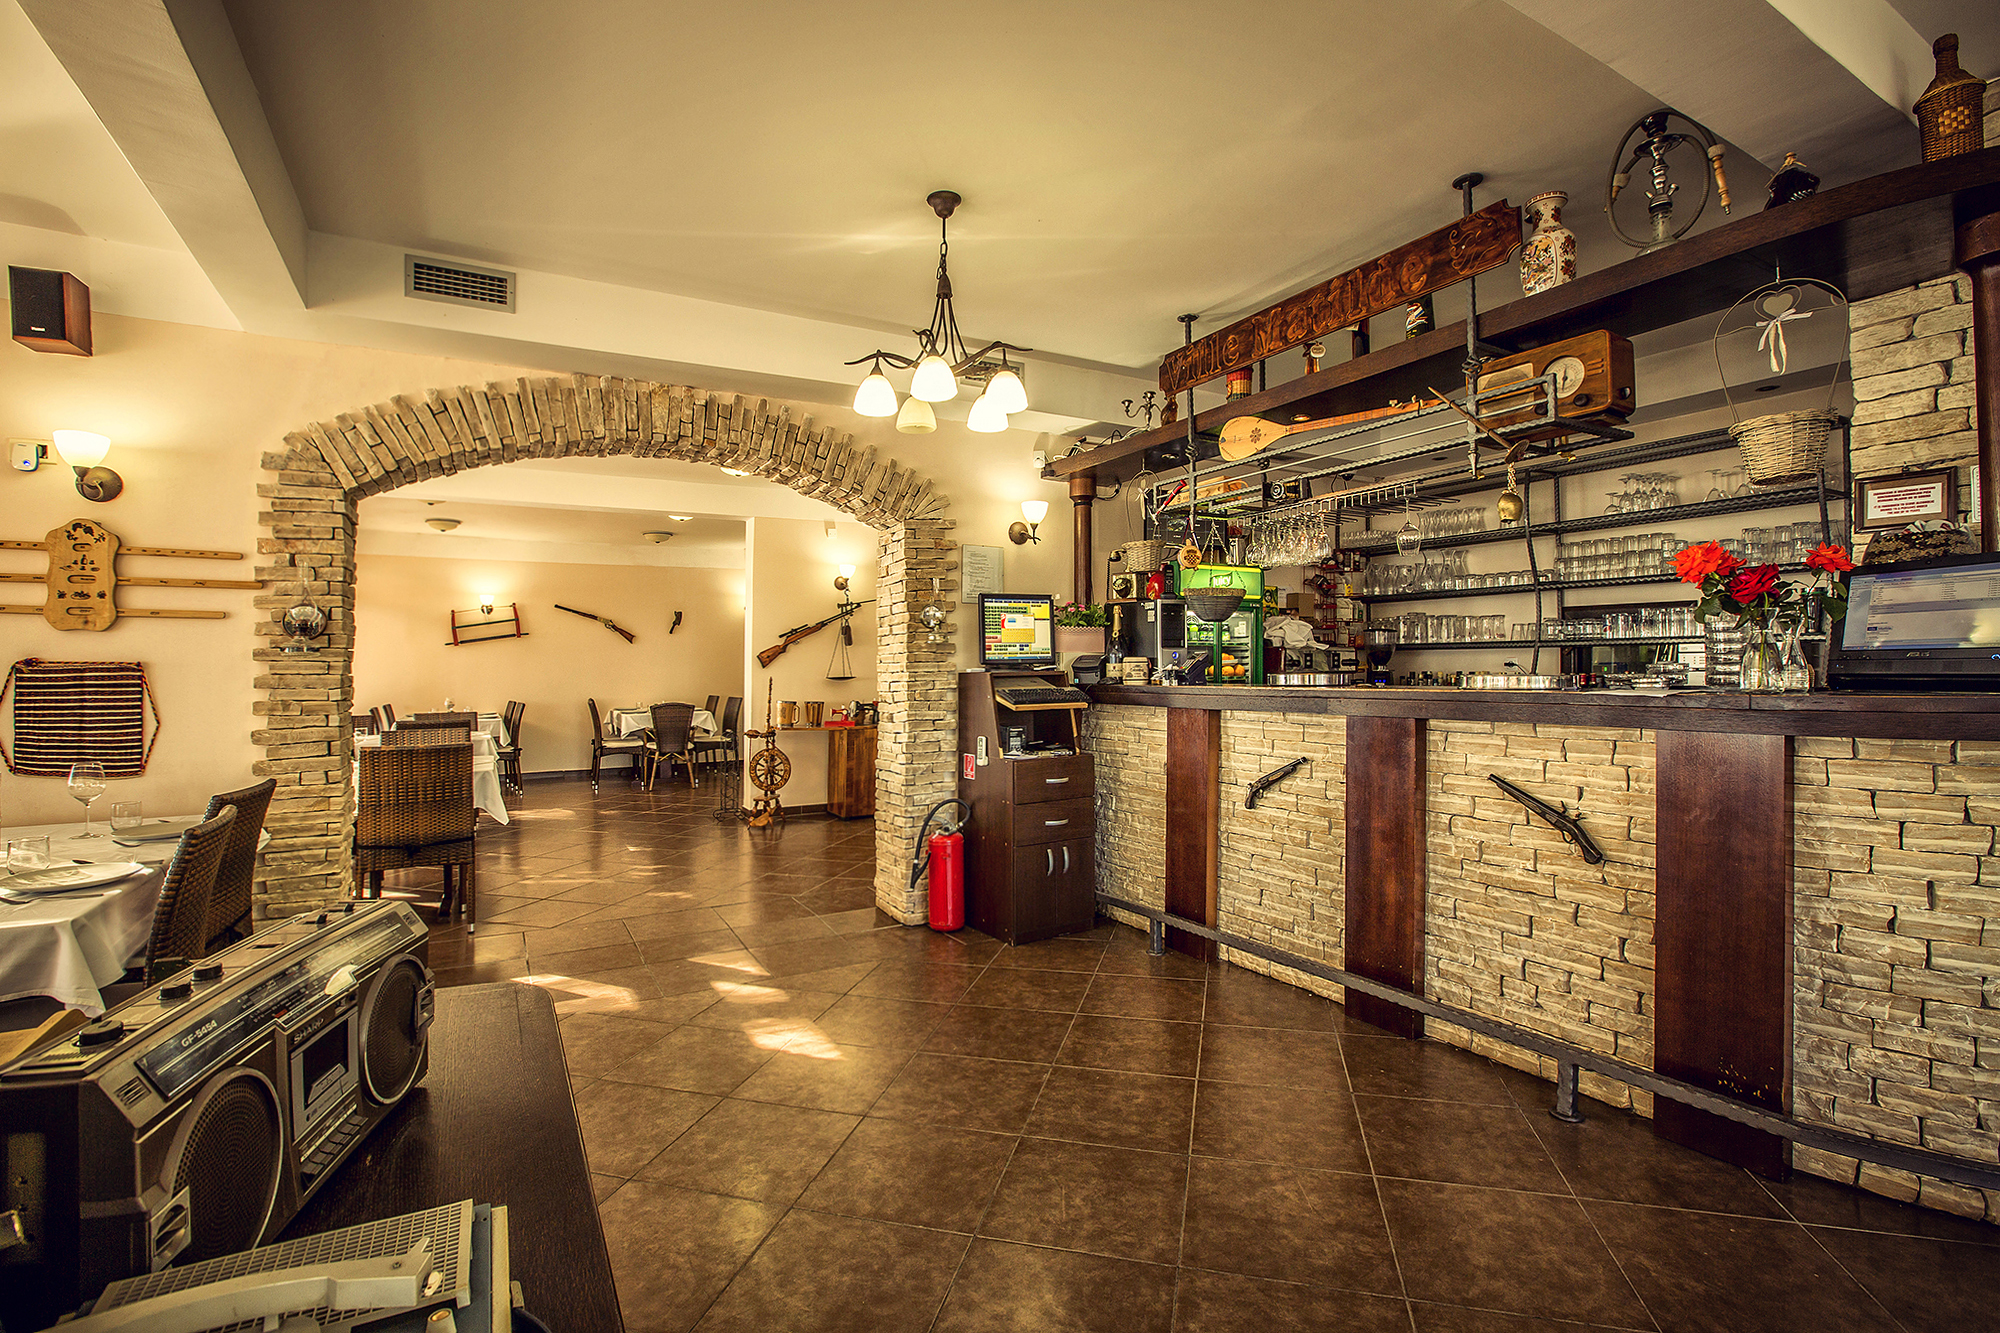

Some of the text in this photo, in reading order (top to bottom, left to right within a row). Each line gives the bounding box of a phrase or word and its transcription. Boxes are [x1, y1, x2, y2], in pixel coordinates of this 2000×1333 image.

[1165, 253, 1428, 390] Ville Matilde
[1212, 575, 1232, 588] Juicy
[181, 1019, 218, 1048] GF-5454
[293, 1017, 325, 1045] SHARP
